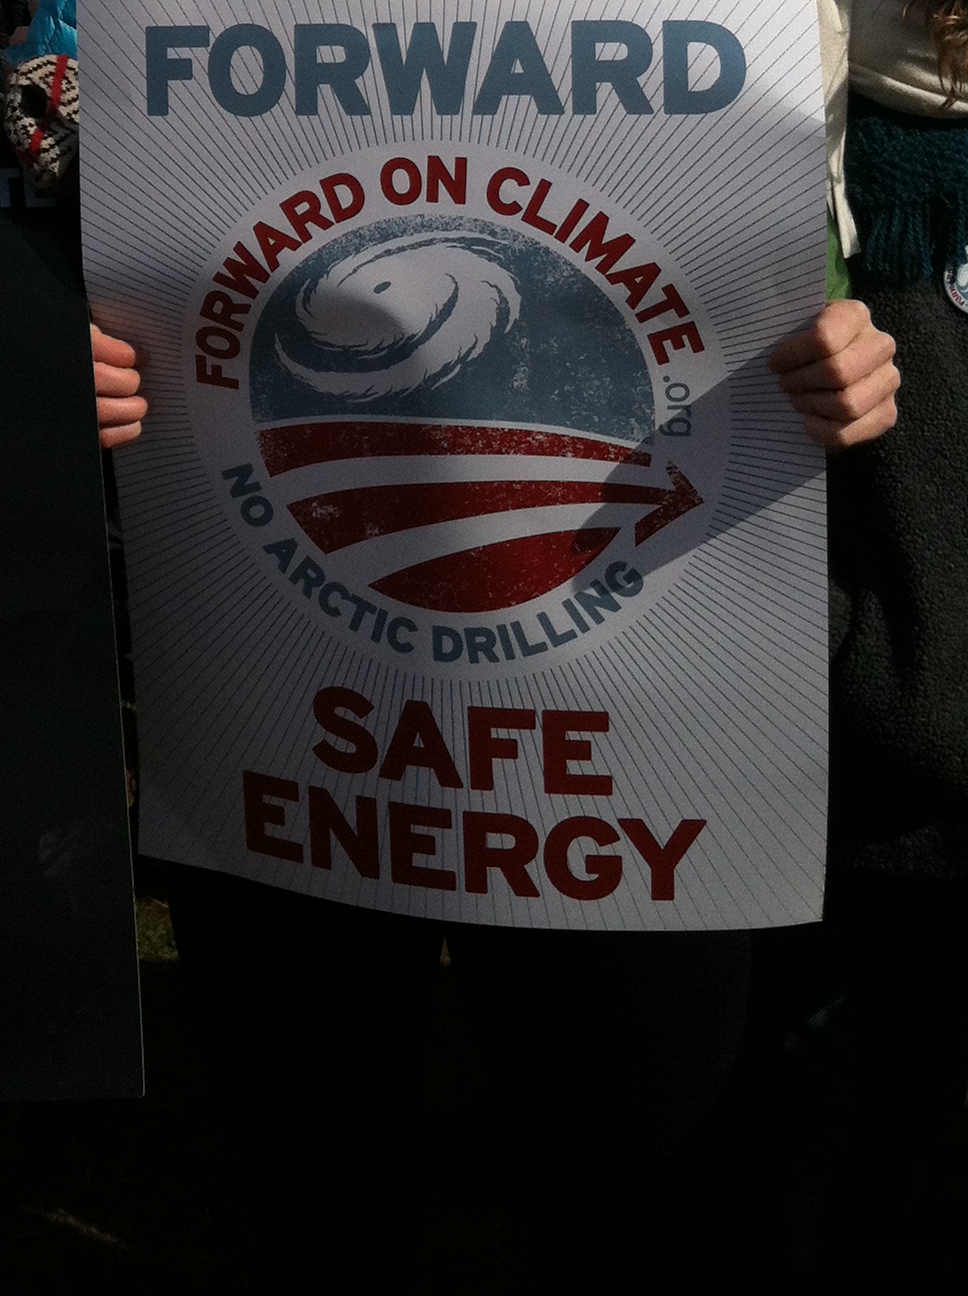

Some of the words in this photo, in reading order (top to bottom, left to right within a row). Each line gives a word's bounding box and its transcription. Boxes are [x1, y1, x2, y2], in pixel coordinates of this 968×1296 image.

[144, 20, 747, 117] FORWARD
[195, 171, 366, 390] FORWARD
[379, 155, 468, 206] ON
[486, 167, 706, 366] CLIMATE
[221, 464, 274, 527] NO
[263, 537, 419, 655] ARCTIC
[431, 560, 645, 664] DRILLING
[311, 685, 614, 797] SAFE
[242, 770, 708, 902] ENERGY
